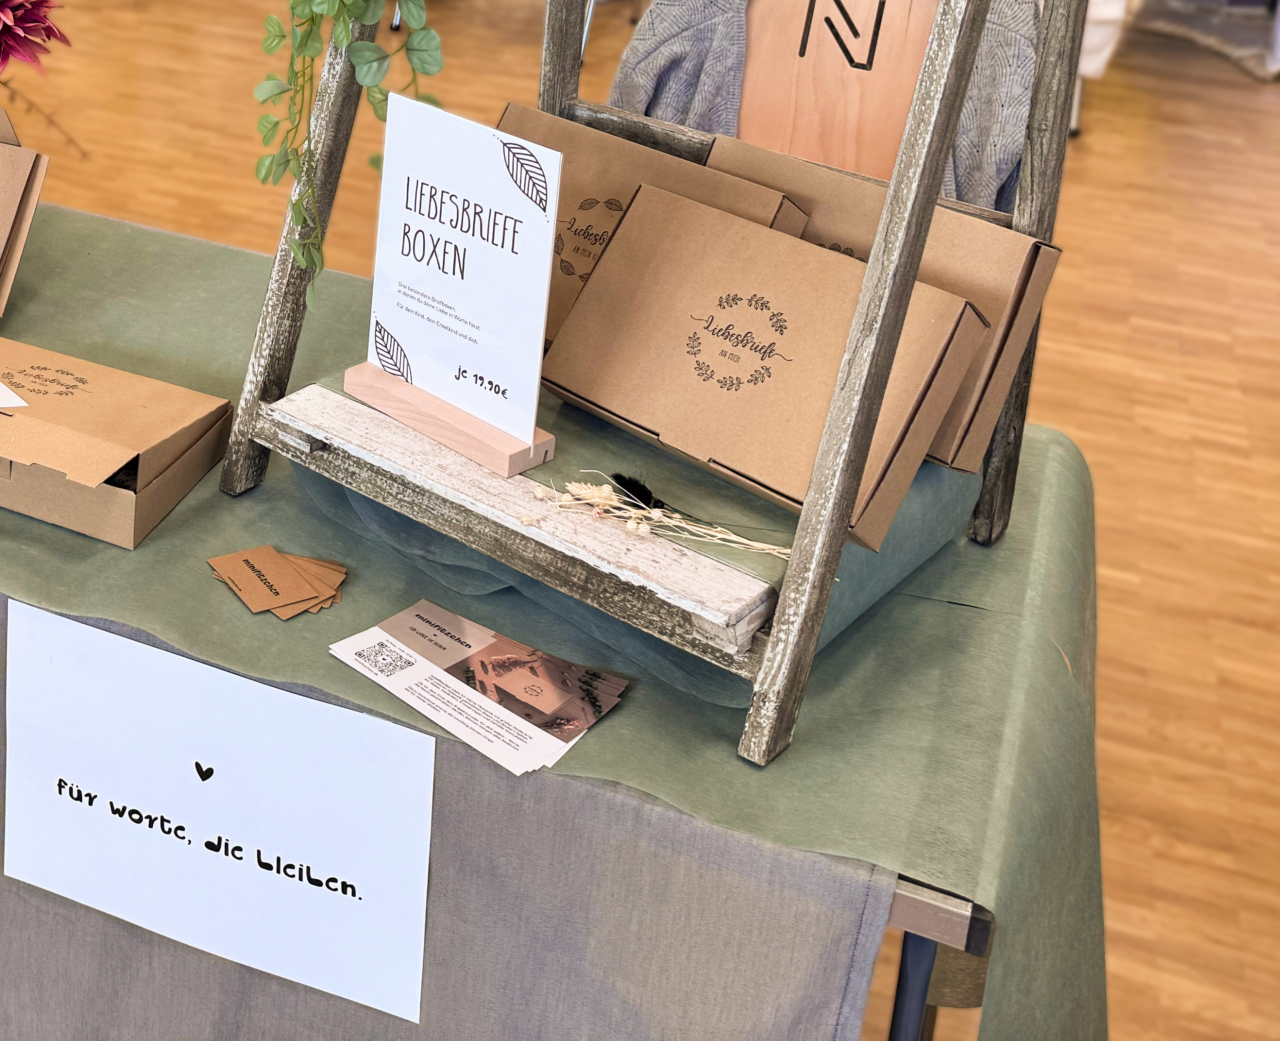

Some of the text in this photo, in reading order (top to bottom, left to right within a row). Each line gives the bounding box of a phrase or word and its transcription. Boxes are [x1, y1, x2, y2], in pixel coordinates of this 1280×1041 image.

[405, 176, 523, 255] LIEBESBRIEFE
[565, 217, 611, 246] Liebesb
[401, 223, 467, 280] BOXEN
[696, 315, 786, 361] Liebesbriefe
[454, 365, 468, 381] je
[242, 559, 280, 596] minifitzchen
[415, 614, 472, 649] minifitzchen
[57, 777, 363, 901] für worte, die bleiben.
